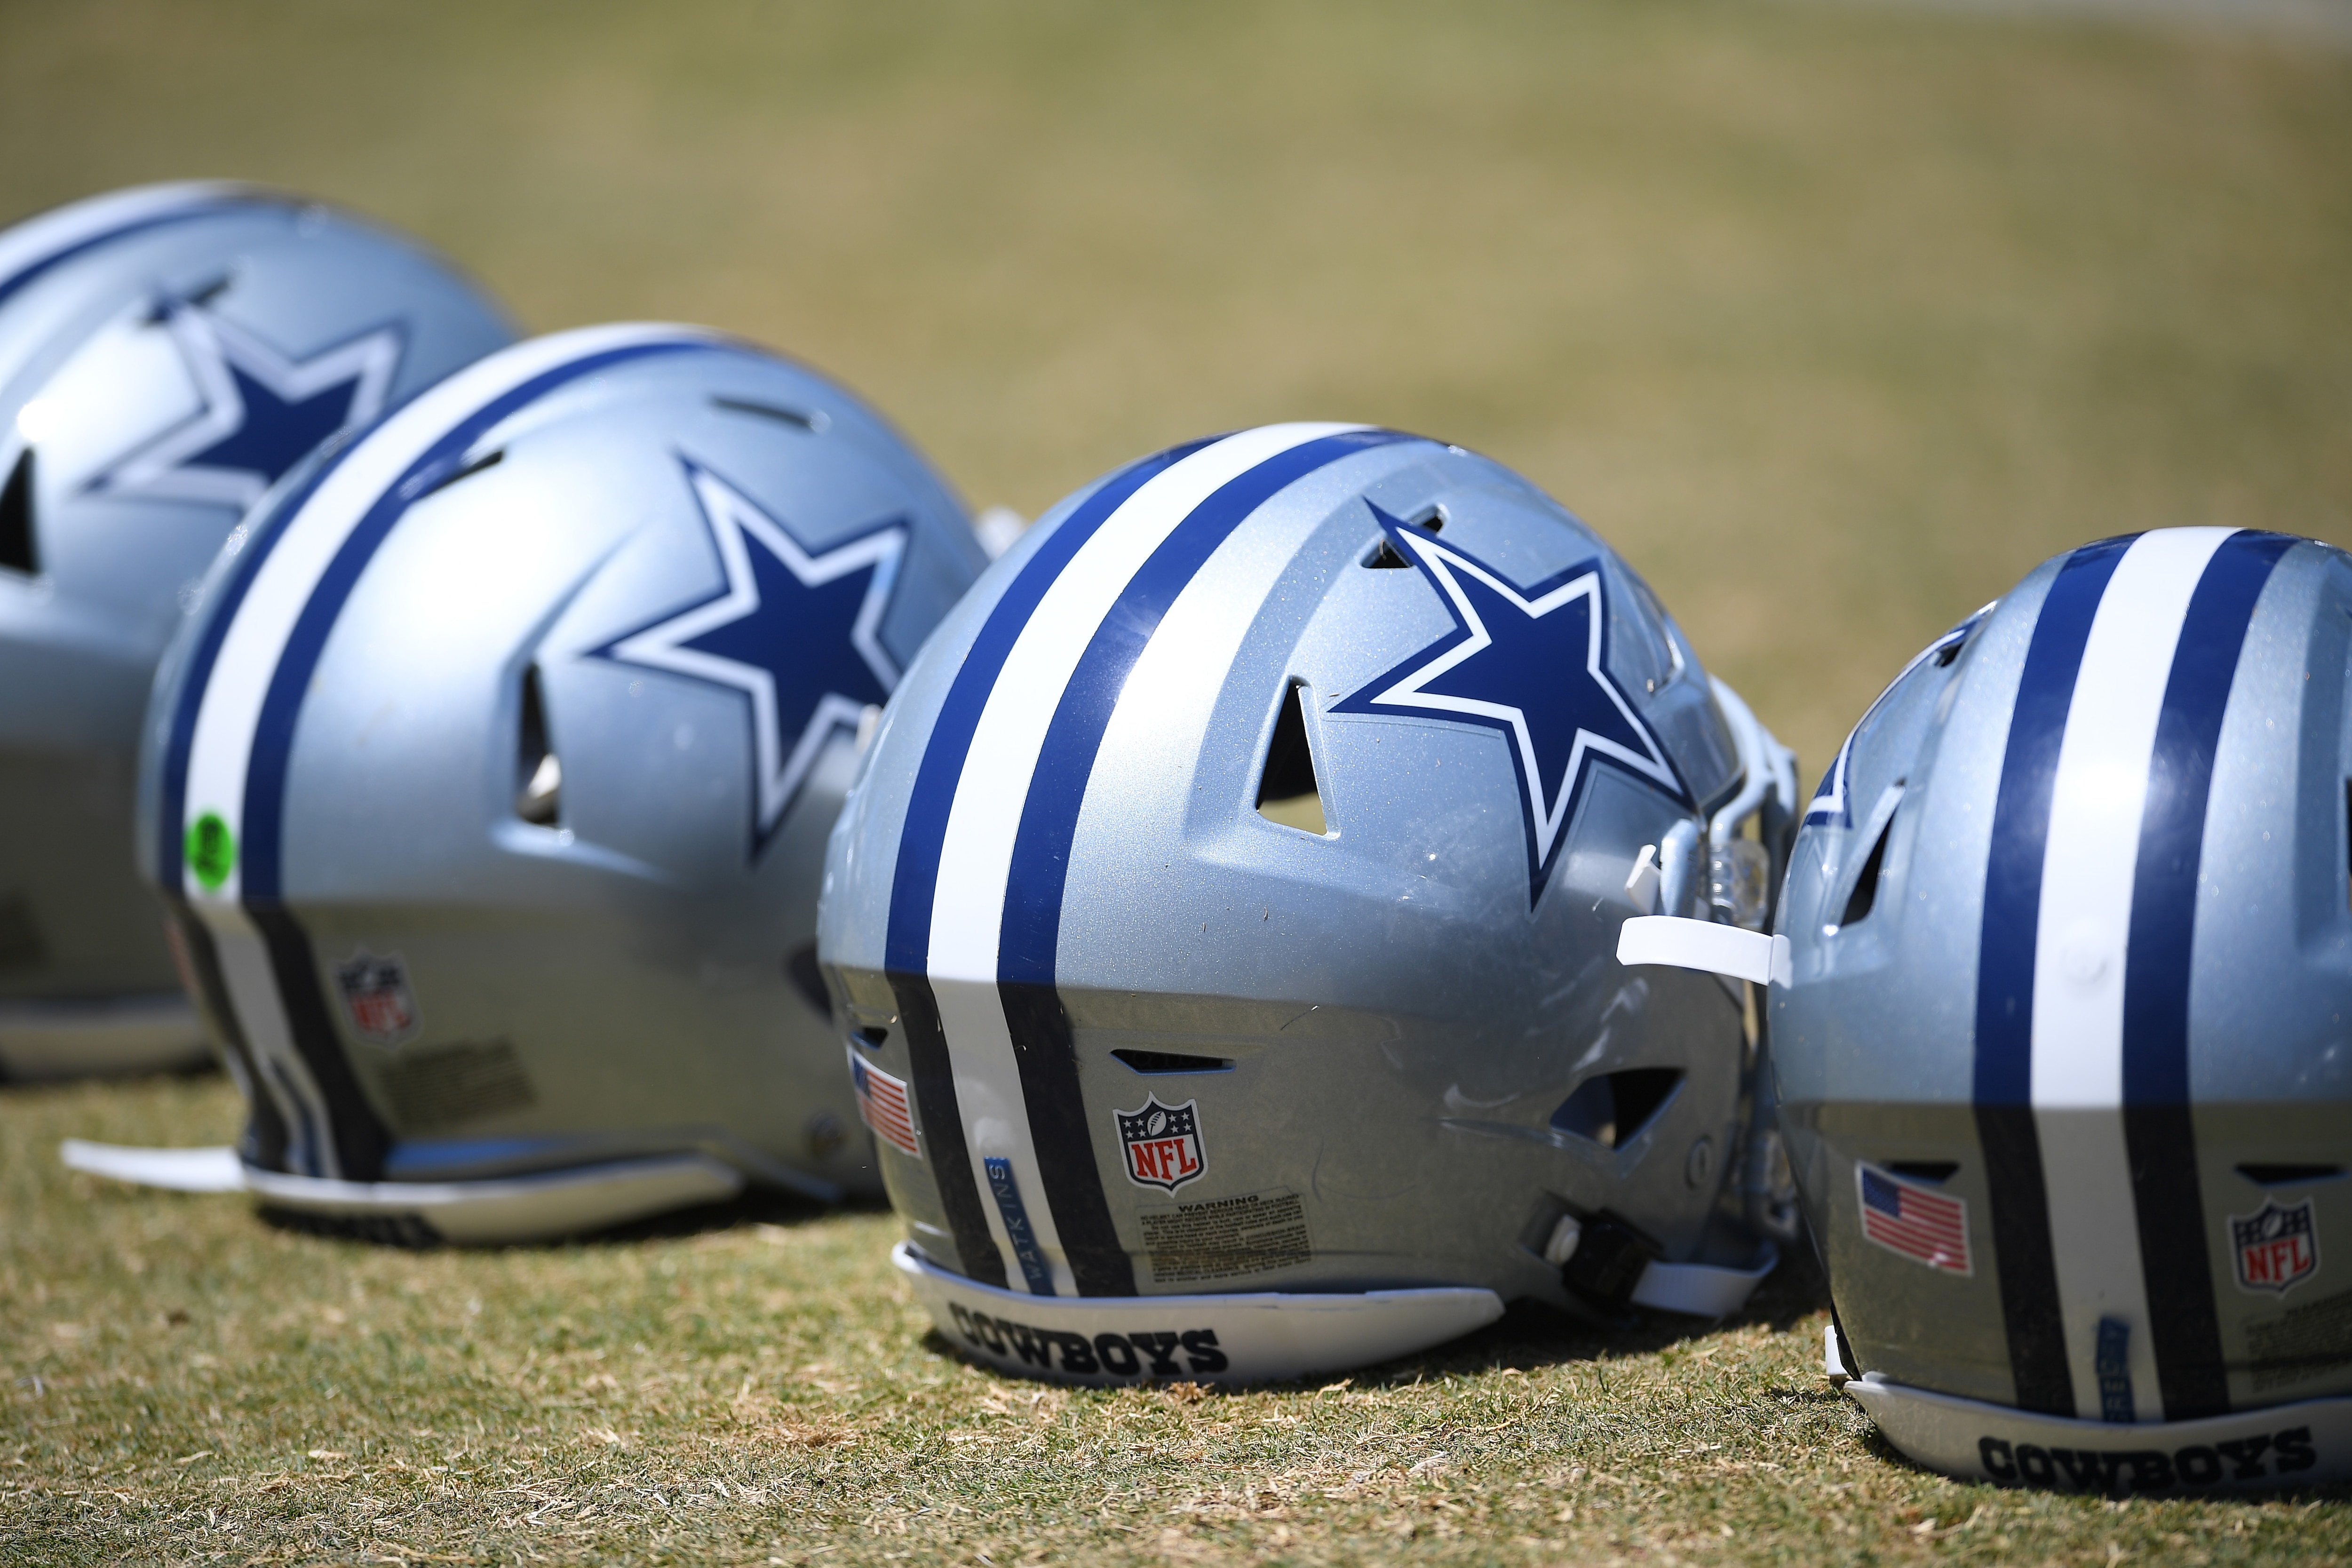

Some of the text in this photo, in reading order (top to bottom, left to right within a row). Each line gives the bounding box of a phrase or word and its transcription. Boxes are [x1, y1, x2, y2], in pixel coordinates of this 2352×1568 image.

[1131, 1138, 1197, 1181] NFL
[988, 1163, 1043, 1280] WATKINS
[1178, 1195, 1259, 1212] WARNING
[2245, 1237, 2310, 1282] NFL
[948, 1301, 1229, 1376] COWBOYS
[1978, 1426, 2317, 1491] COWBOYS
